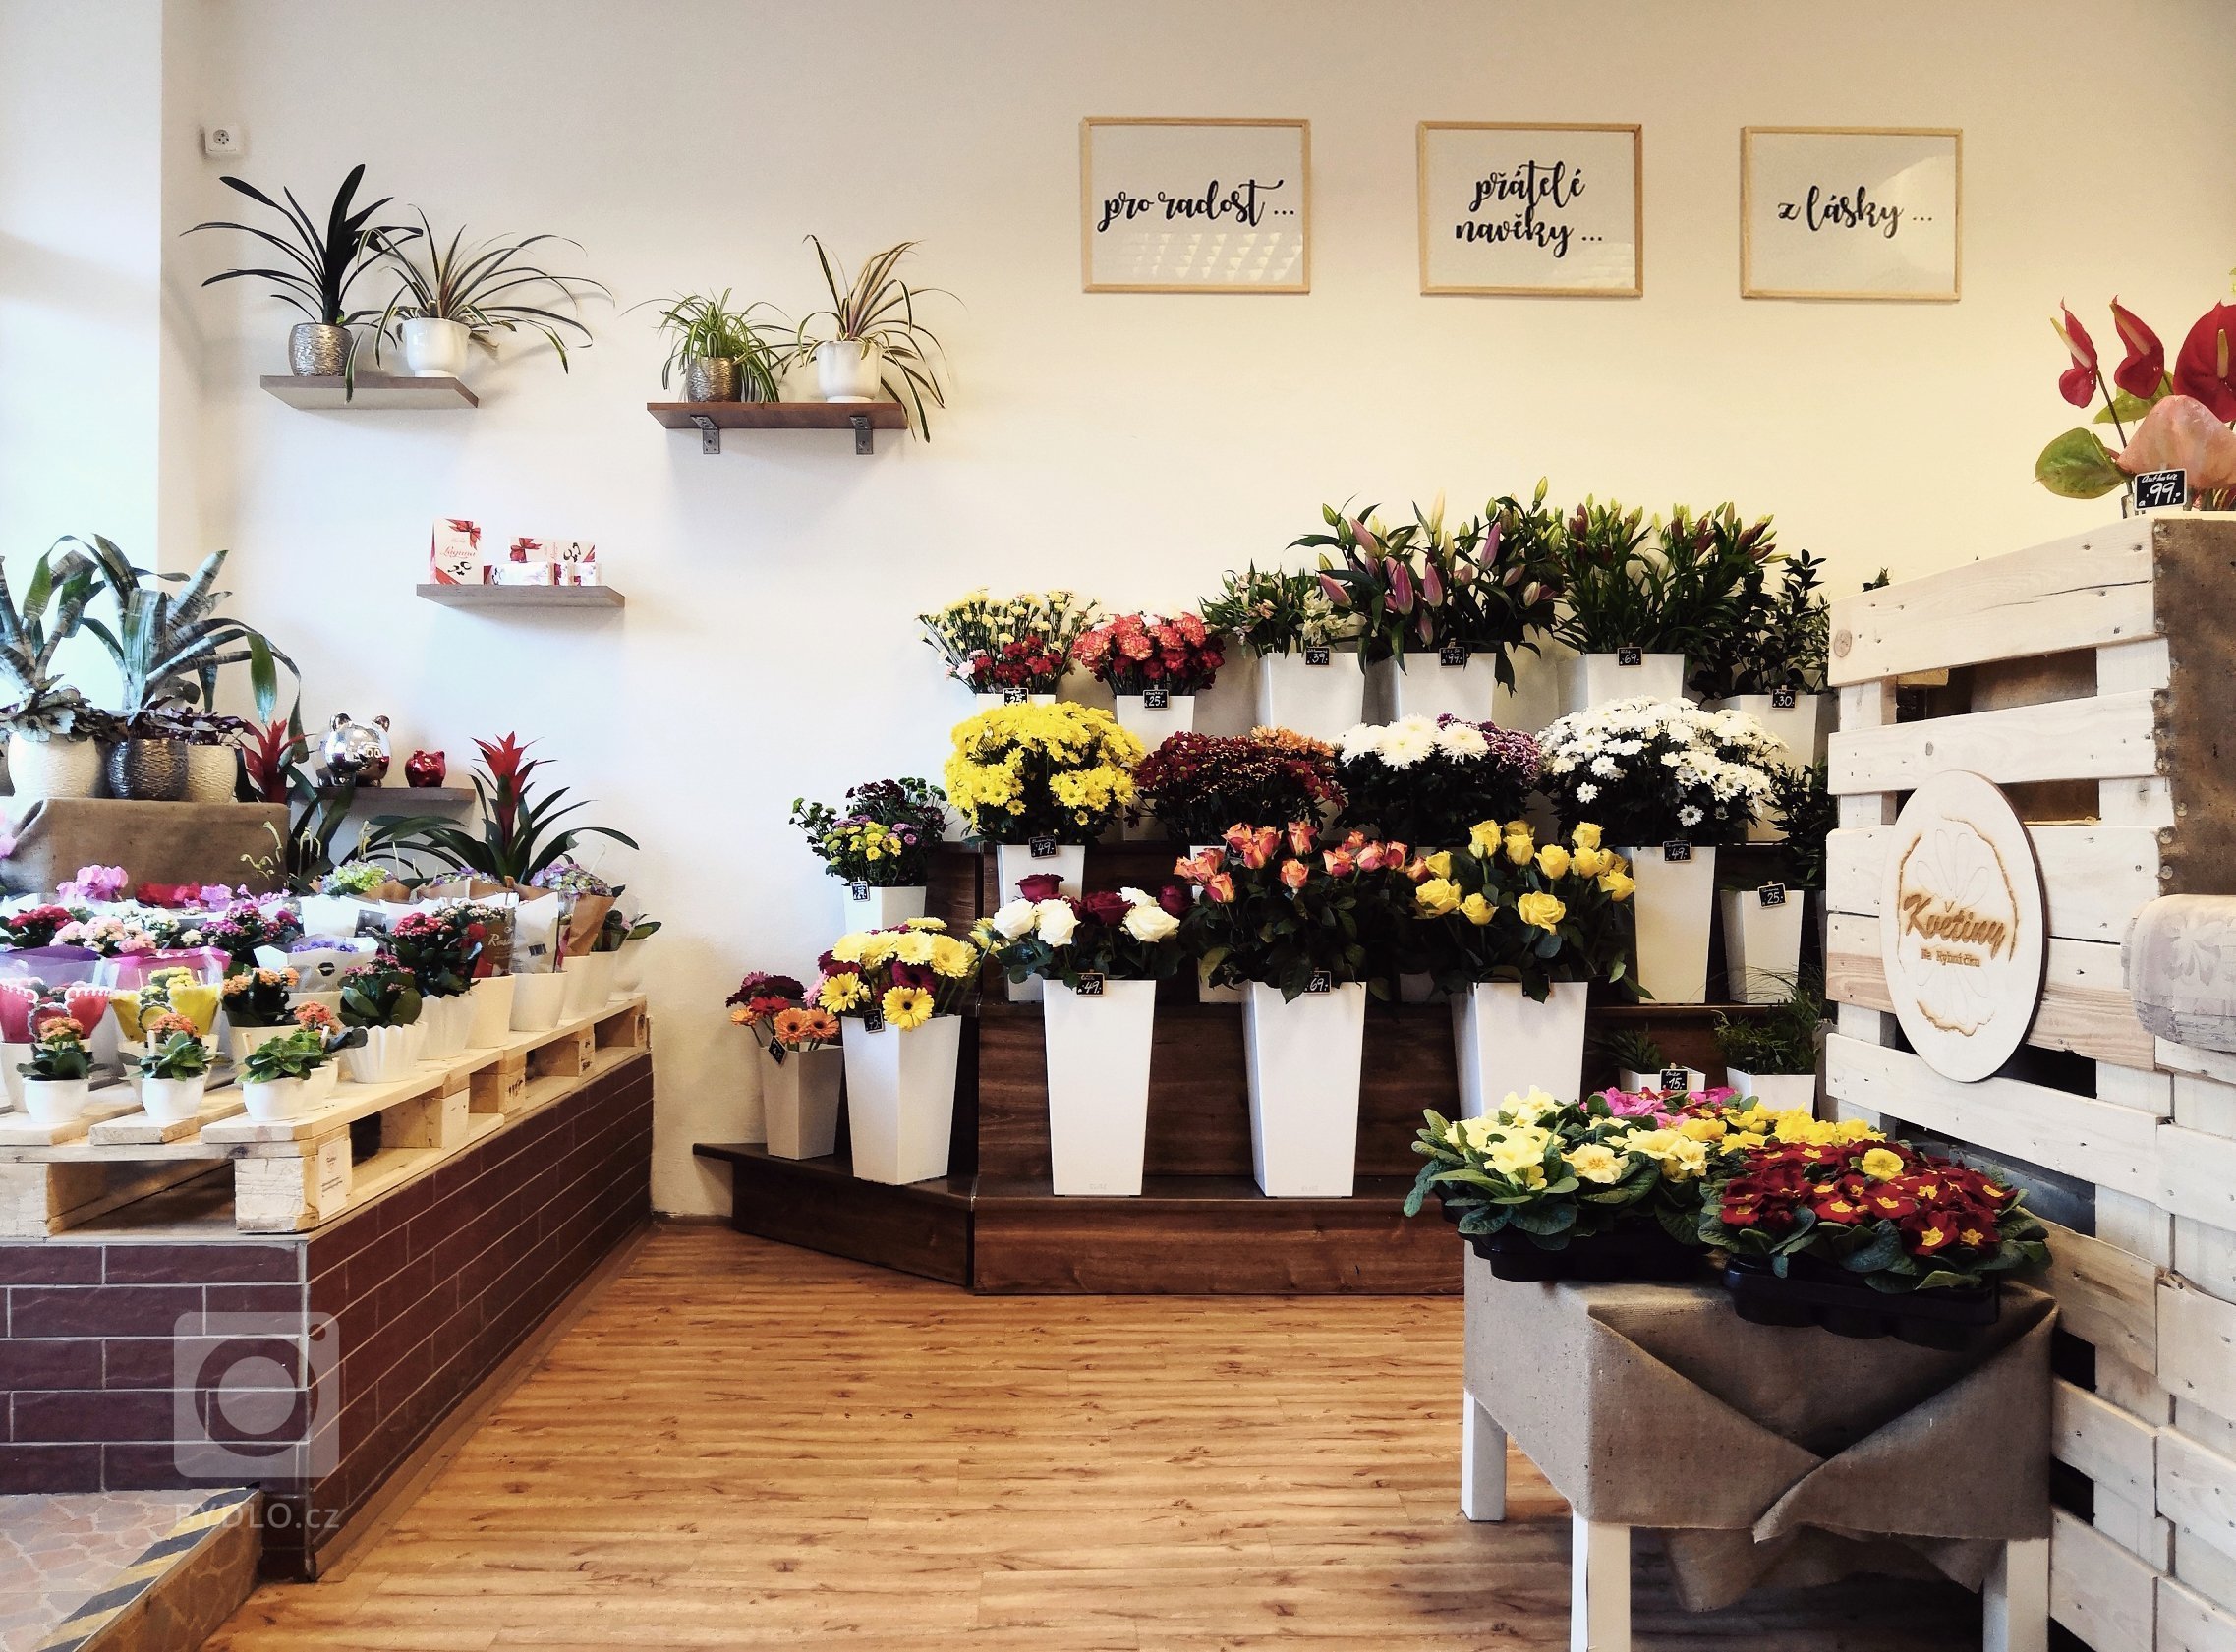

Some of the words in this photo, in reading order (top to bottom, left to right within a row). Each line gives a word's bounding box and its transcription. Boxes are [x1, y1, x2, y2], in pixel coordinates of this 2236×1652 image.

[1097, 190, 1154, 233] pro
[1158, 179, 1284, 227] radost
[1468, 159, 1586, 213] přátelé
[1777, 202, 1801, 221] z
[1806, 185, 1905, 239] lásky
[1455, 206, 1575, 258] navěky
